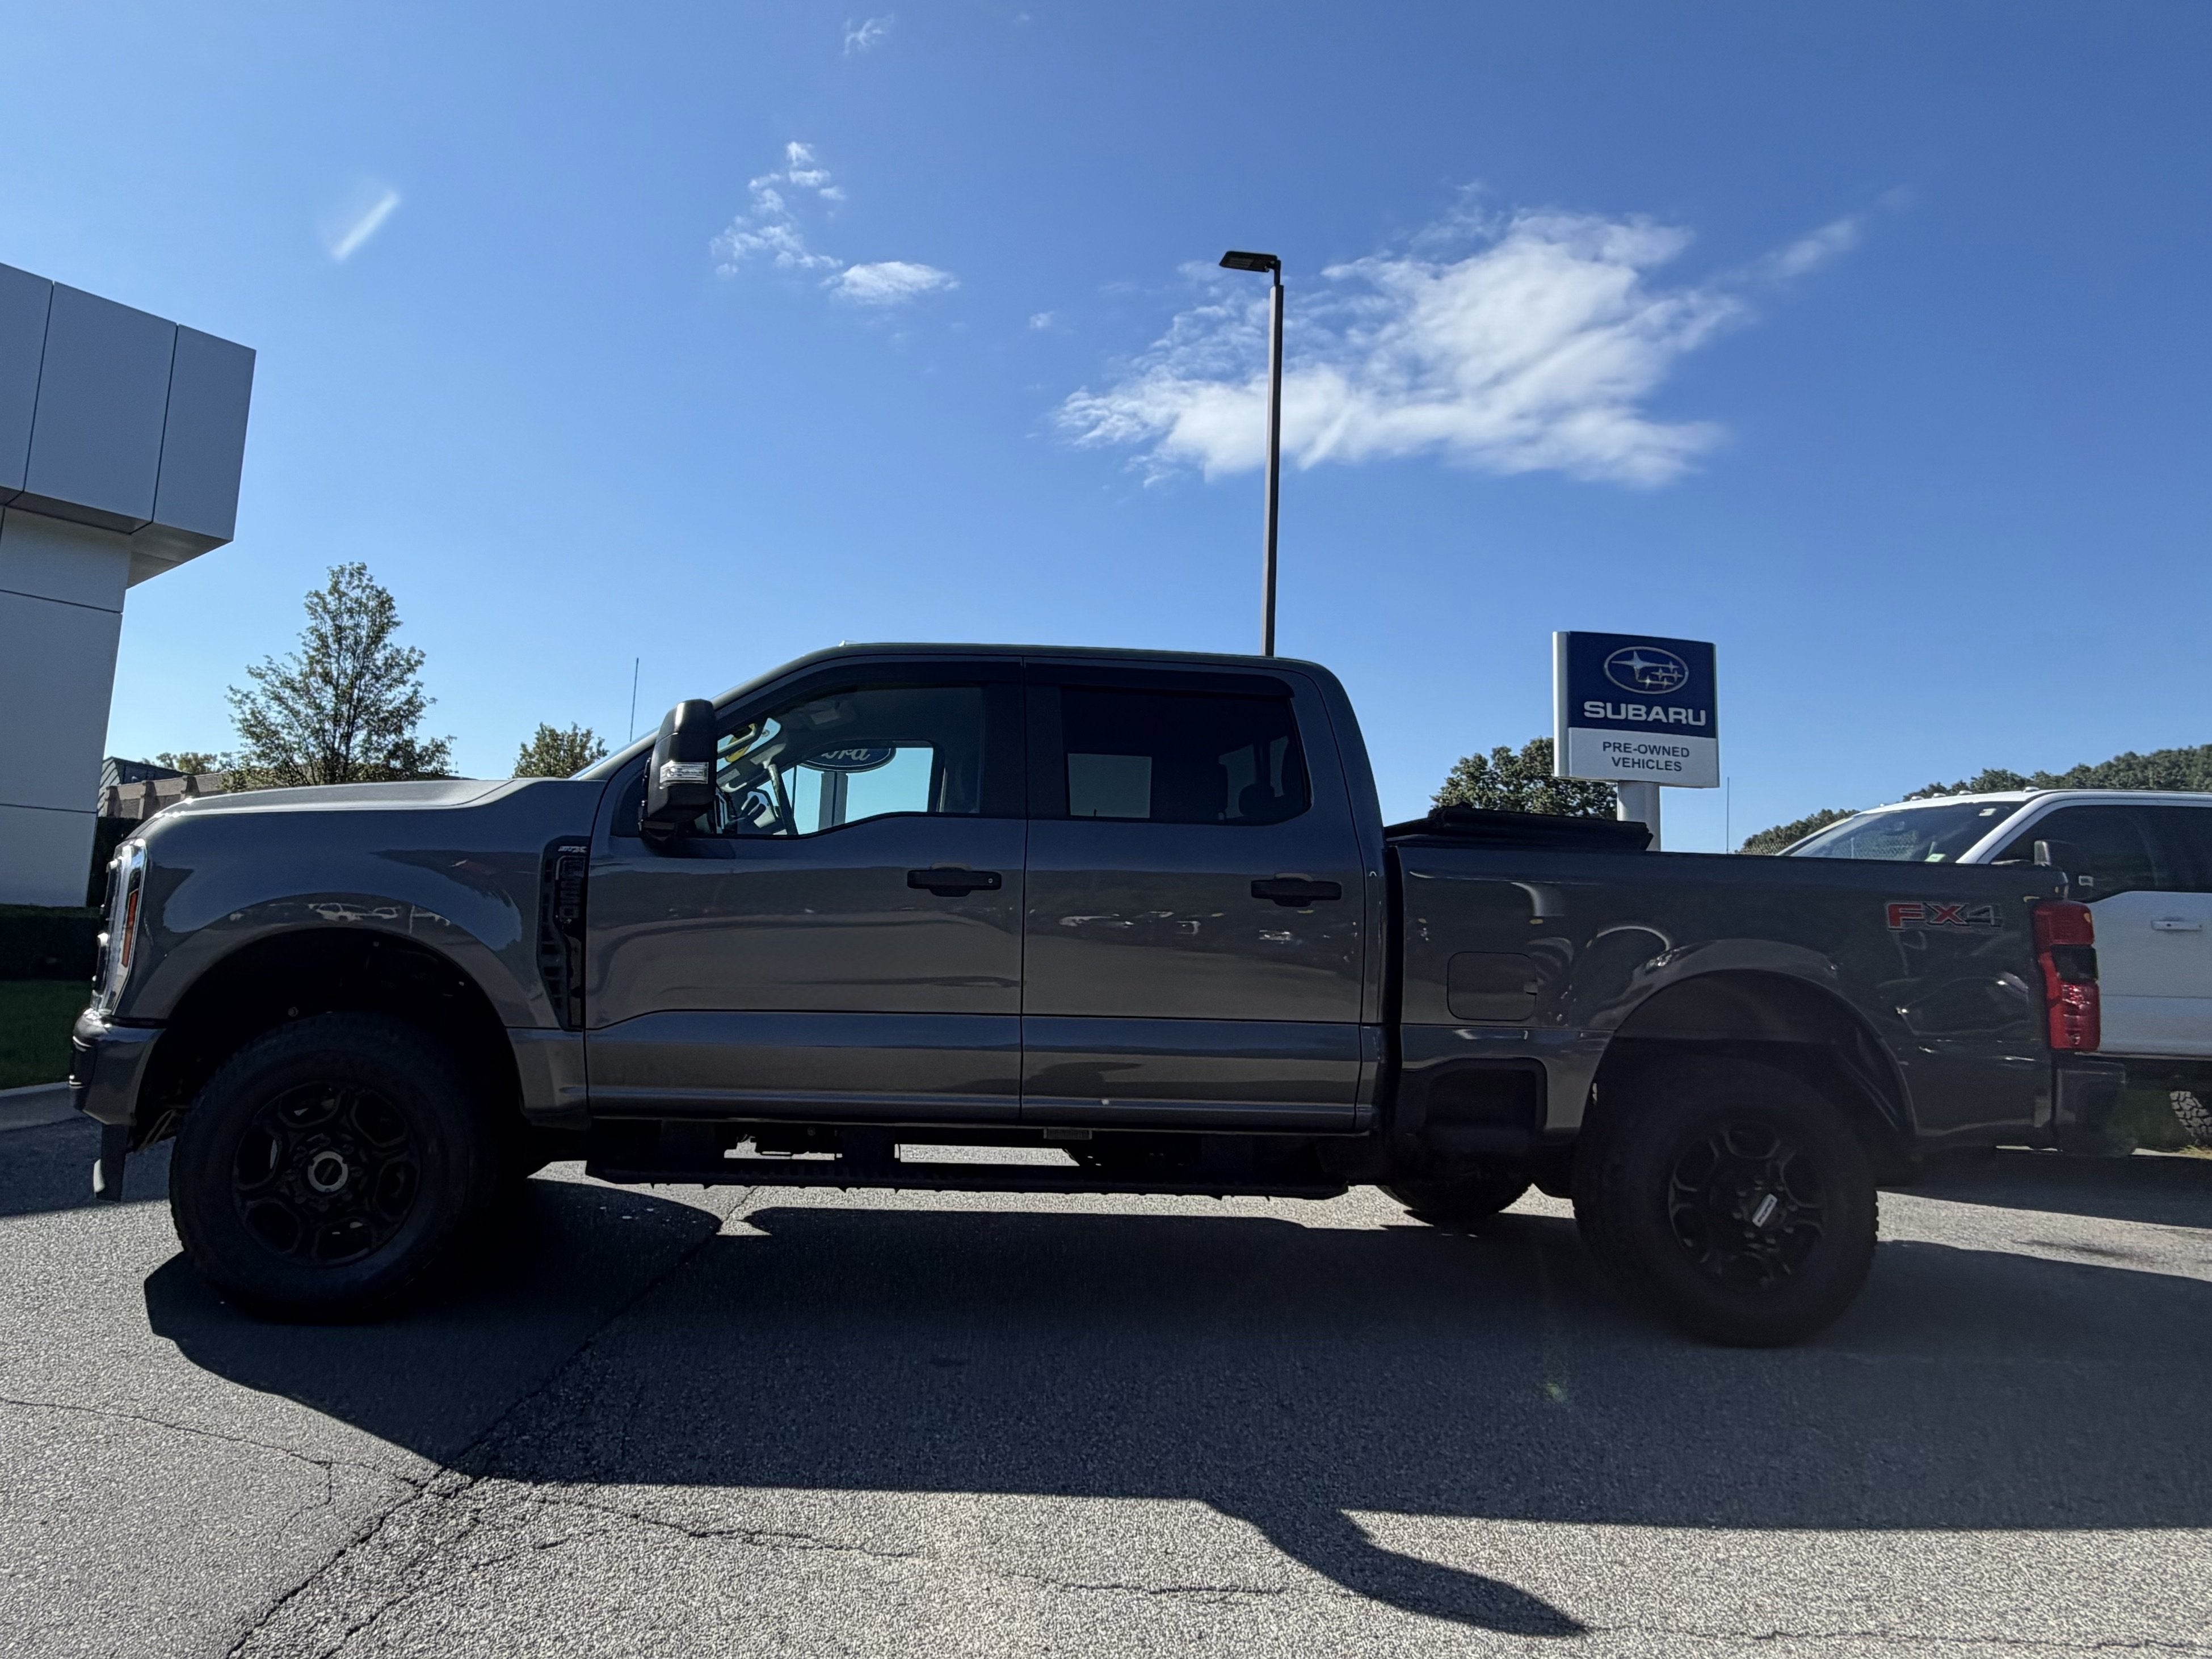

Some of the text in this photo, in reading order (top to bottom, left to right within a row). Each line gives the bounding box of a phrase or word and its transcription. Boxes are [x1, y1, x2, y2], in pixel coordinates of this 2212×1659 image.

[1583, 701, 1706, 726] SUBARU
[1602, 741, 1690, 758] PRE-OWNED
[1611, 756, 1683, 772] VEHICLES
[1887, 902, 2002, 930] FX4
